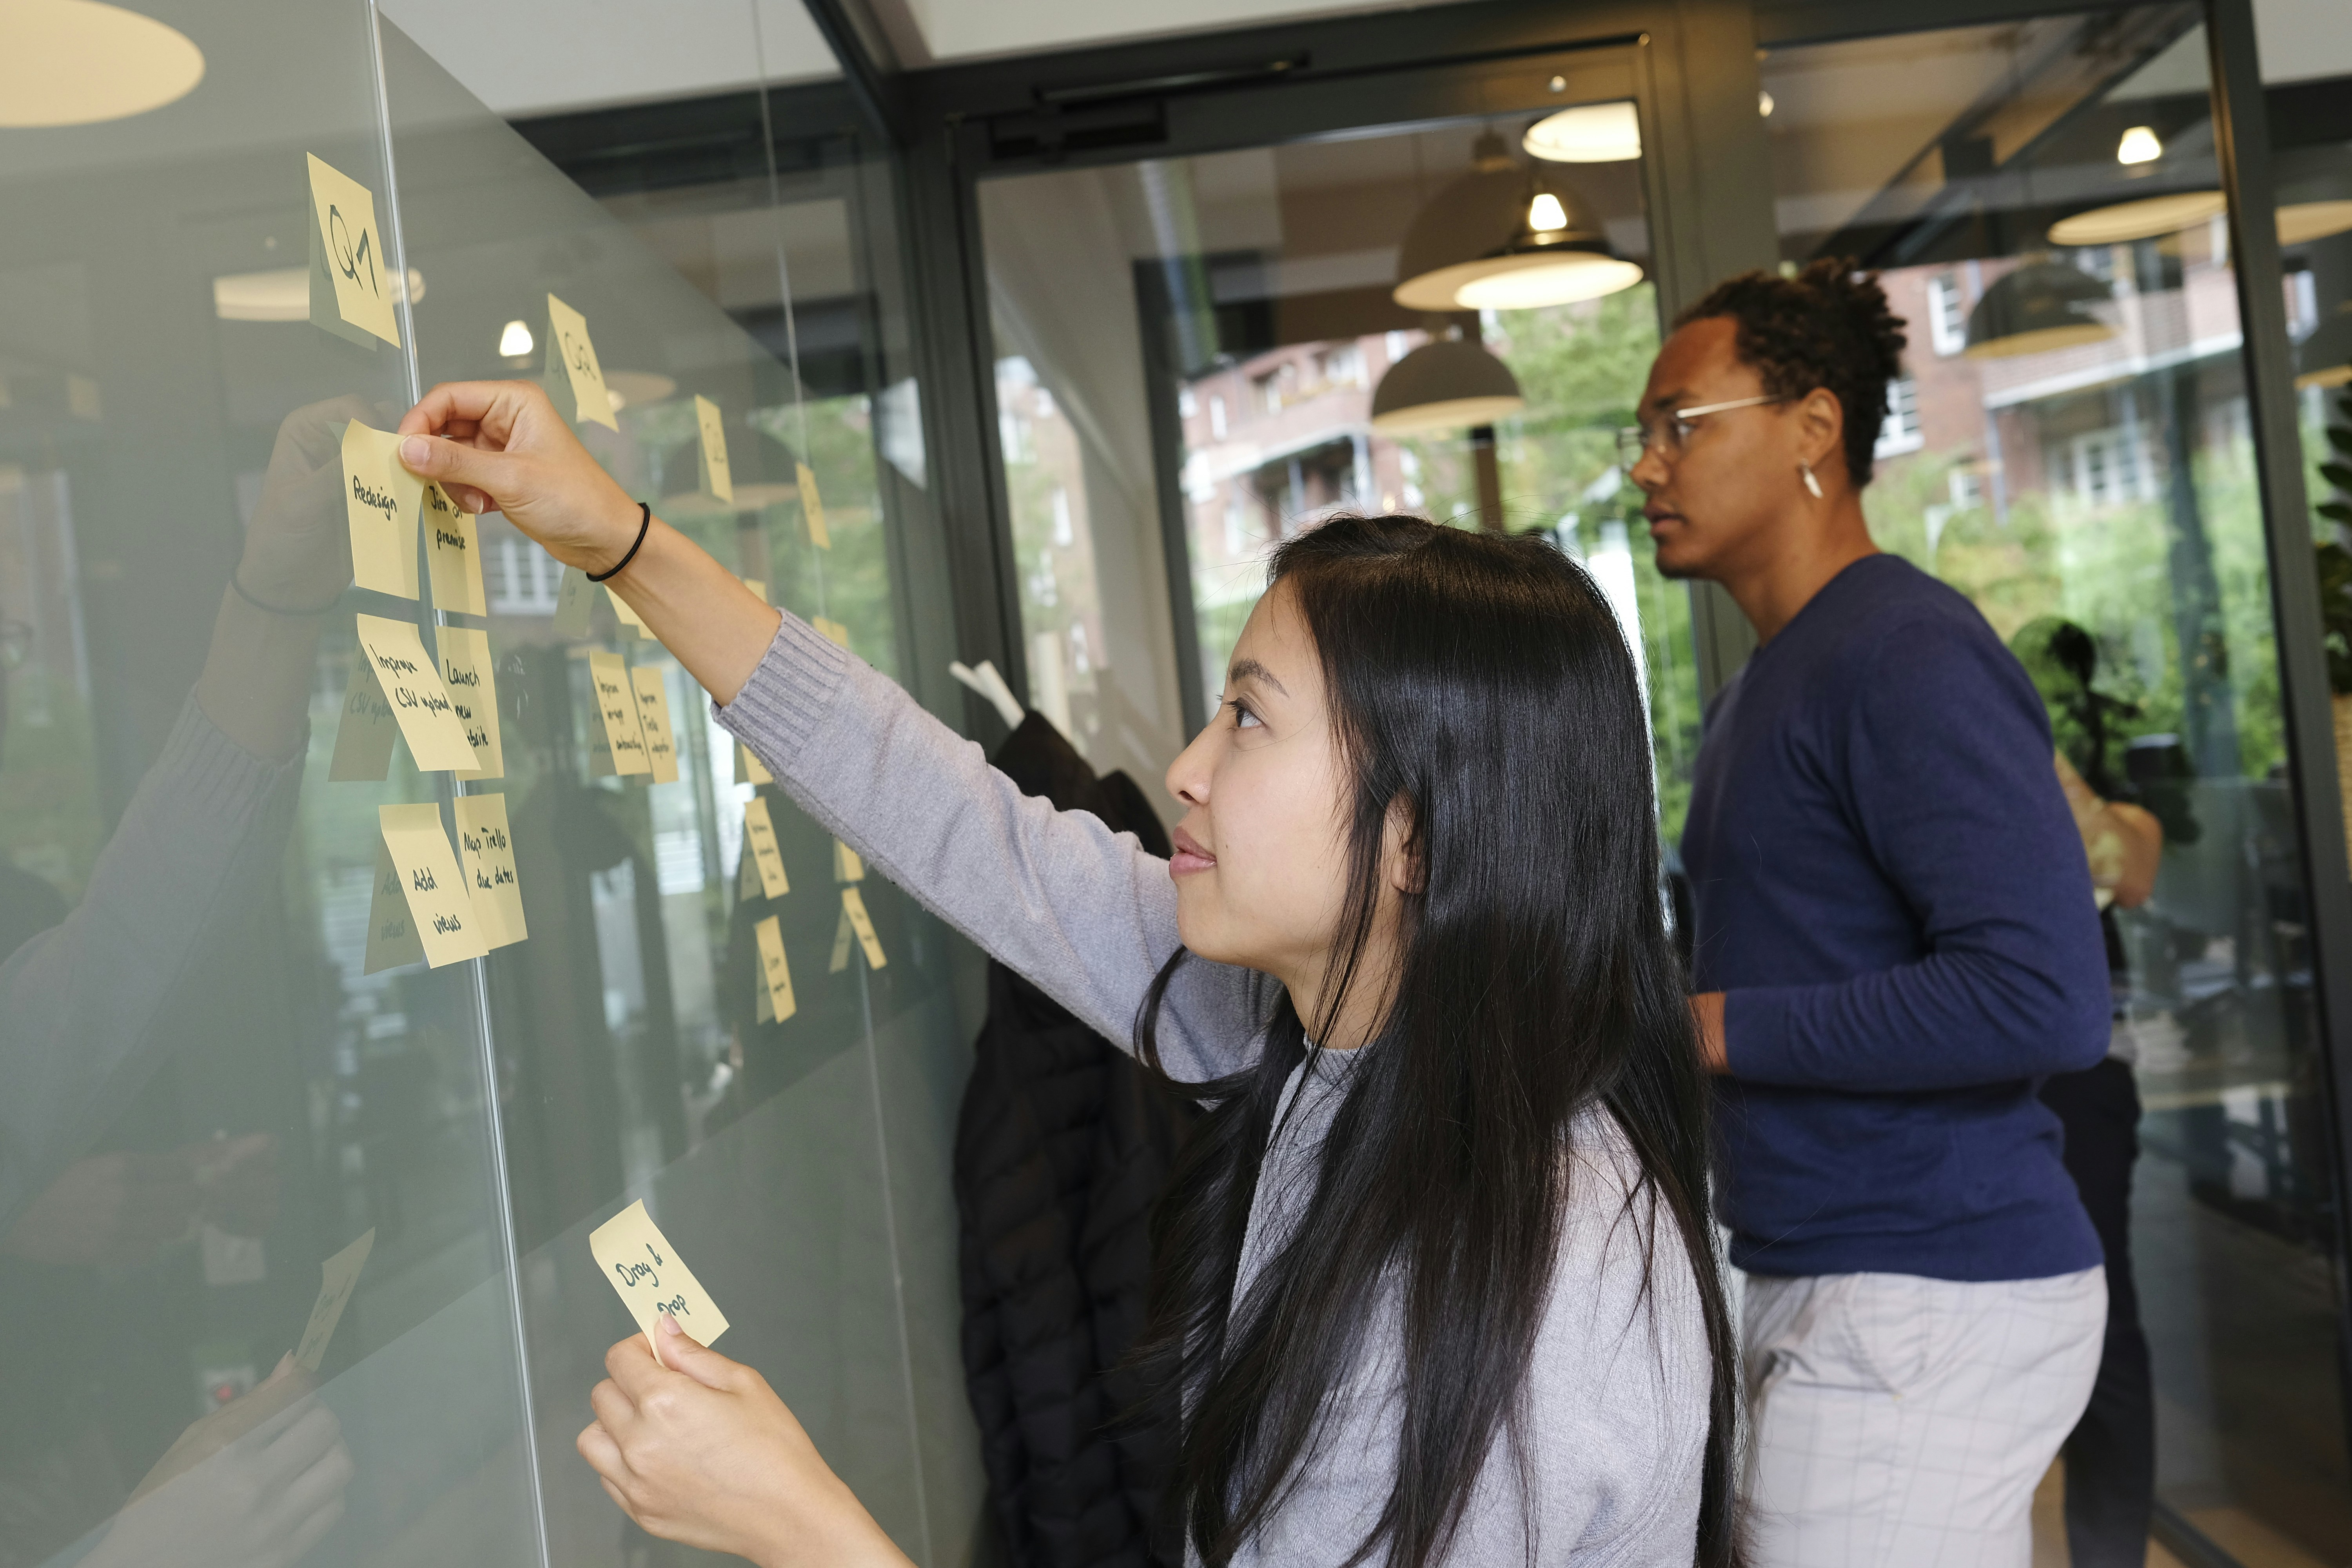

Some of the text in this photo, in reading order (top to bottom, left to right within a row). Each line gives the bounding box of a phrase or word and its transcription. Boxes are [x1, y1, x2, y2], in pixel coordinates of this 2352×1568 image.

[330, 204, 379, 300] Q1
[353, 474, 397, 521] Redesign
[429, 485, 448, 512] Jira
[436, 528, 466, 550] premise
[368, 643, 418, 679] Improve
[446, 659, 480, 687] Launch
[395, 687, 453, 718] CSV upload
[455, 704, 472, 719] new
[466, 725, 488, 748] bsite
[463, 827, 506, 859] Map Trello
[413, 866, 438, 892] Add
[476, 865, 514, 889] due dates
[433, 913, 462, 935] views
[615, 1262, 659, 1288] Drag
